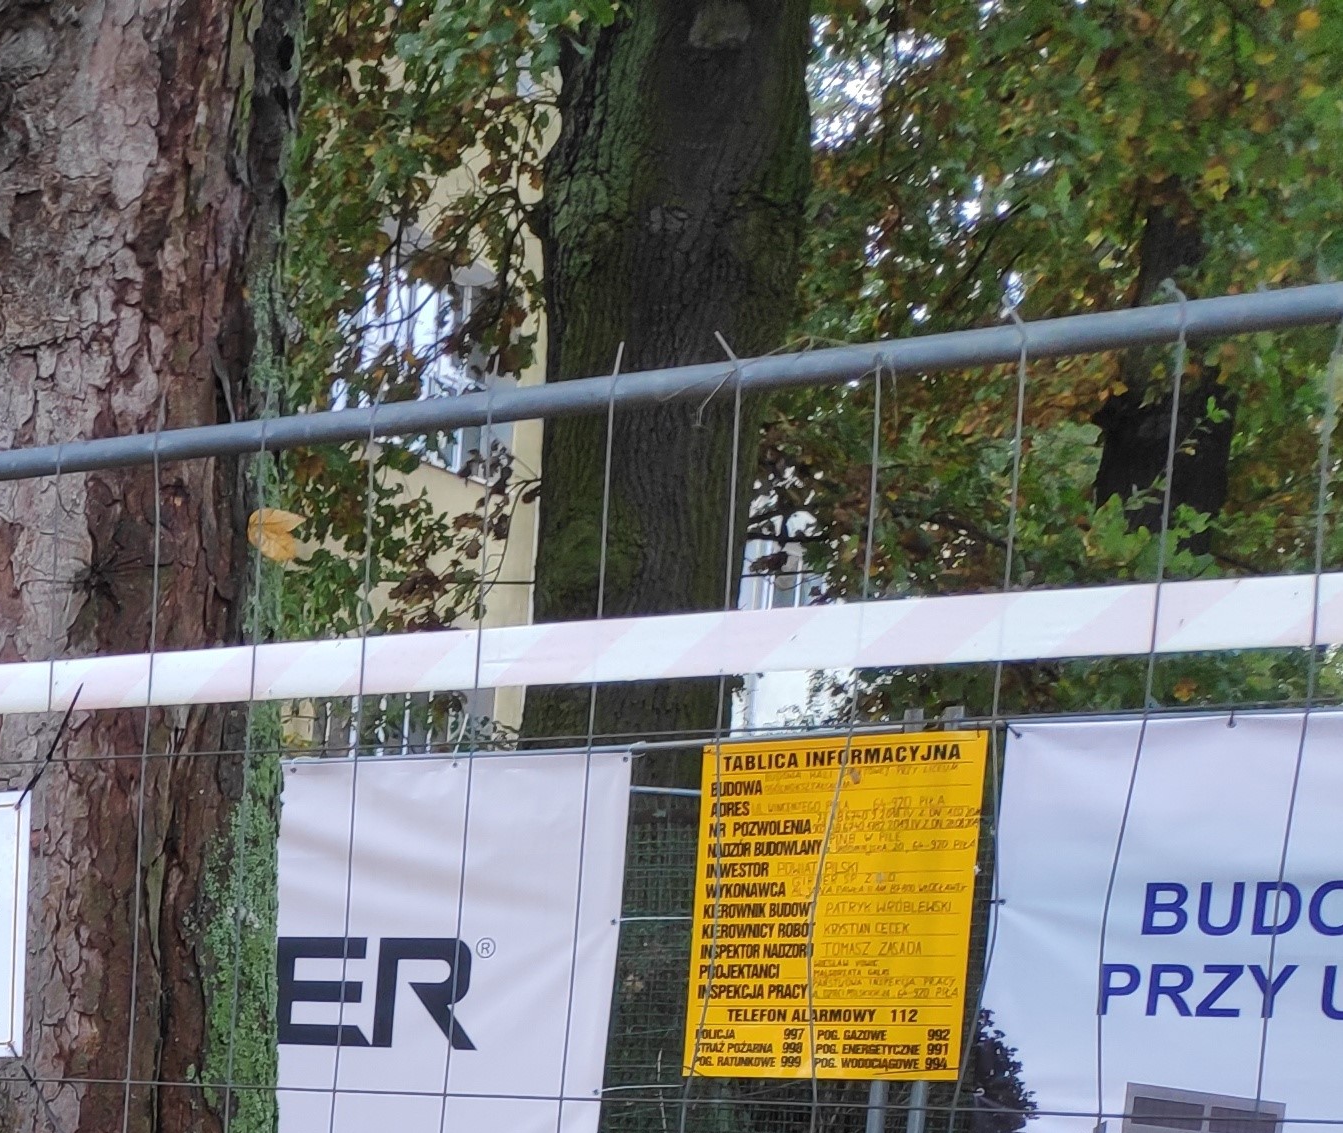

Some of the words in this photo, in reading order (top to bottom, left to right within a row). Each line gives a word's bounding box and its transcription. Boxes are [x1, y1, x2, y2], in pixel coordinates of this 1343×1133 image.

[723, 752, 799, 772] TABLICA
[805, 744, 961, 768] INFORMACYJNA
[710, 780, 763, 797] BUDOWA
[710, 801, 750, 817] ADRES
[708, 822, 726, 838] NR
[732, 819, 812, 838] POZWOLENIA
[707, 839, 751, 859] NADZÓR
[754, 839, 824, 857] BUDOWLANY
[706, 862, 770, 879] INWESTOR
[705, 882, 786, 898] WYKONAWCA
[703, 902, 767, 919] KIEROWNIK
[769, 901, 815, 918] BUDOW
[701, 923, 776, 939] KIEROWNICY
[700, 943, 761, 960] INSPEKTOR
[698, 983, 764, 1000] INSPEKCJA
[767, 983, 809, 1000] PRACY
[1097, 963, 1300, 1018] PRZY
[727, 1009, 786, 1023] TELEFON
[791, 1008, 877, 1023] ALARMOWY
[890, 1008, 918, 1023] 112
[695, 1028, 735, 1040] POLICJA
[783, 1027, 805, 1040] 997
[816, 1029, 840, 1041] POG.
[843, 1029, 887, 1041] GAZOWE
[926, 1028, 951, 1041] 992
[695, 1040, 725, 1053] TRAŻ
[727, 1040, 774, 1054] POŻARNA
[781, 1041, 803, 1055] 998
[815, 1043, 838, 1055] POG.
[842, 1043, 921, 1056] ENERGETYCZNE
[927, 1042, 949, 1055] 991
[717, 1055, 777, 1068] RATUNKOWE
[780, 1055, 801, 1068] 999
[841, 1057, 920, 1071] WODOCIĄGOWE
[925, 1056, 948, 1070] 994
